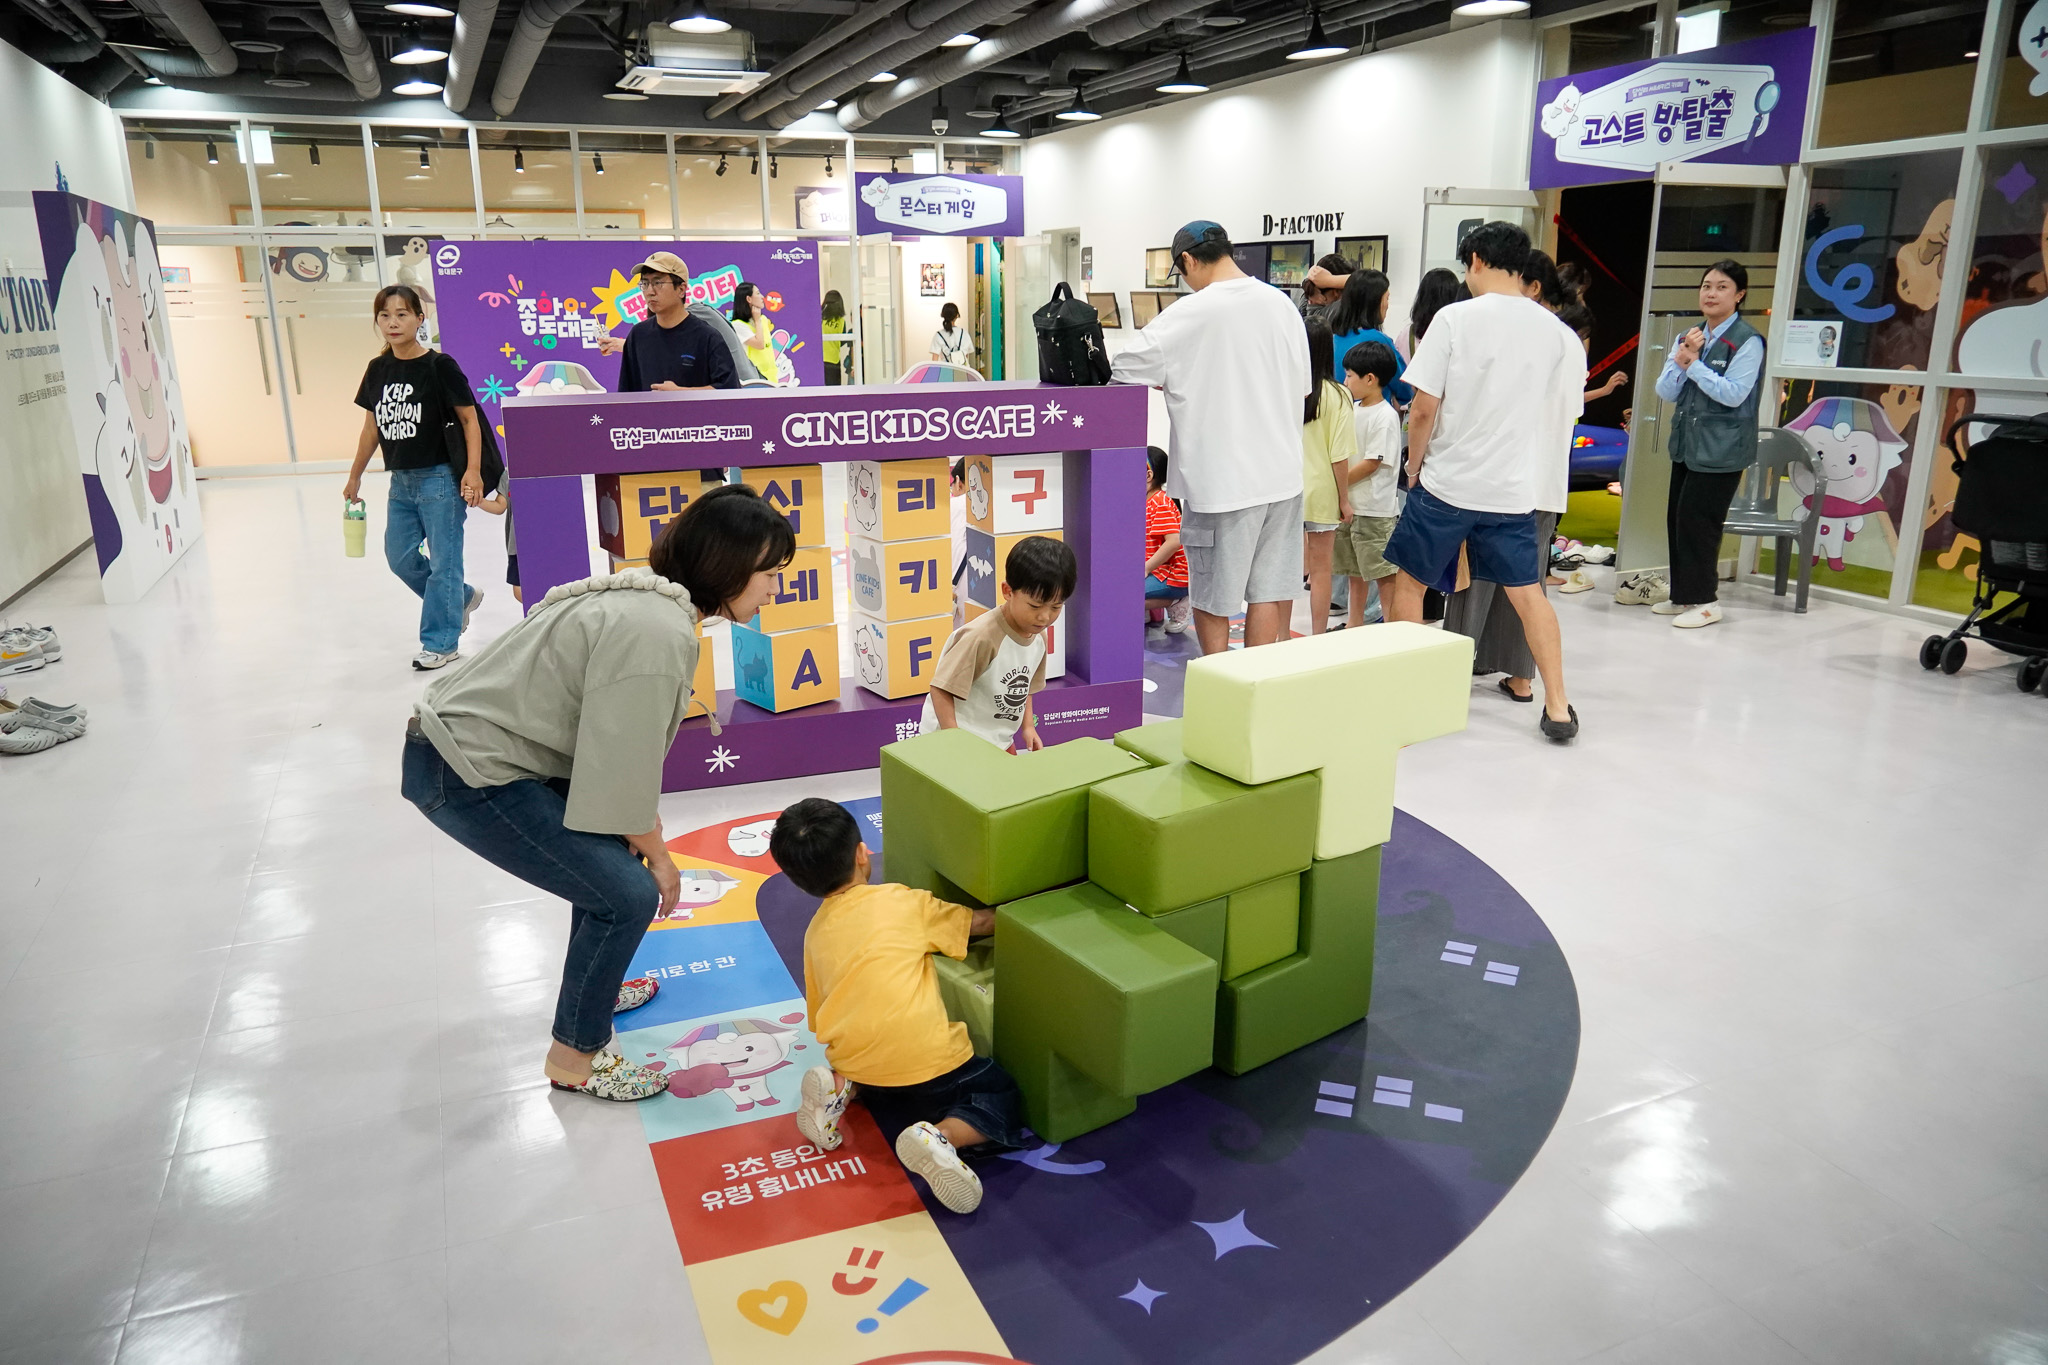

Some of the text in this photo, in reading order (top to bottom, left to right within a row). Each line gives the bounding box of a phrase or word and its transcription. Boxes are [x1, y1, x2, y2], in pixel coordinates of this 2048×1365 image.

[1580, 88, 1735, 146] 고스트 방탈출
[900, 197, 976, 219] 몬스터 게임
[1262, 212, 1345, 237] D-FACTORY
[437, 267, 464, 276] 동대문구
[382, 383, 414, 404] KEEP
[375, 400, 422, 427] FASHION
[782, 405, 1035, 447] CINE KIDS CAFE
[380, 421, 417, 441] WEIRD
[610, 425, 753, 450] 답십리 씨네키즈 카페
[897, 478, 936, 513] 리
[1011, 469, 1048, 515] 구
[855, 573, 880, 590] CINE KIDS
[899, 559, 938, 594] 키
[861, 585, 874, 598] CAFE
[791, 636, 932, 691] A F
[1043, 712, 1060, 721] 답십리
[687, 960, 712, 974] 한
[714, 955, 737, 969] 칸
[721, 1157, 769, 1182] 3초
[700, 1156, 868, 1212] 유령 흉내내기
